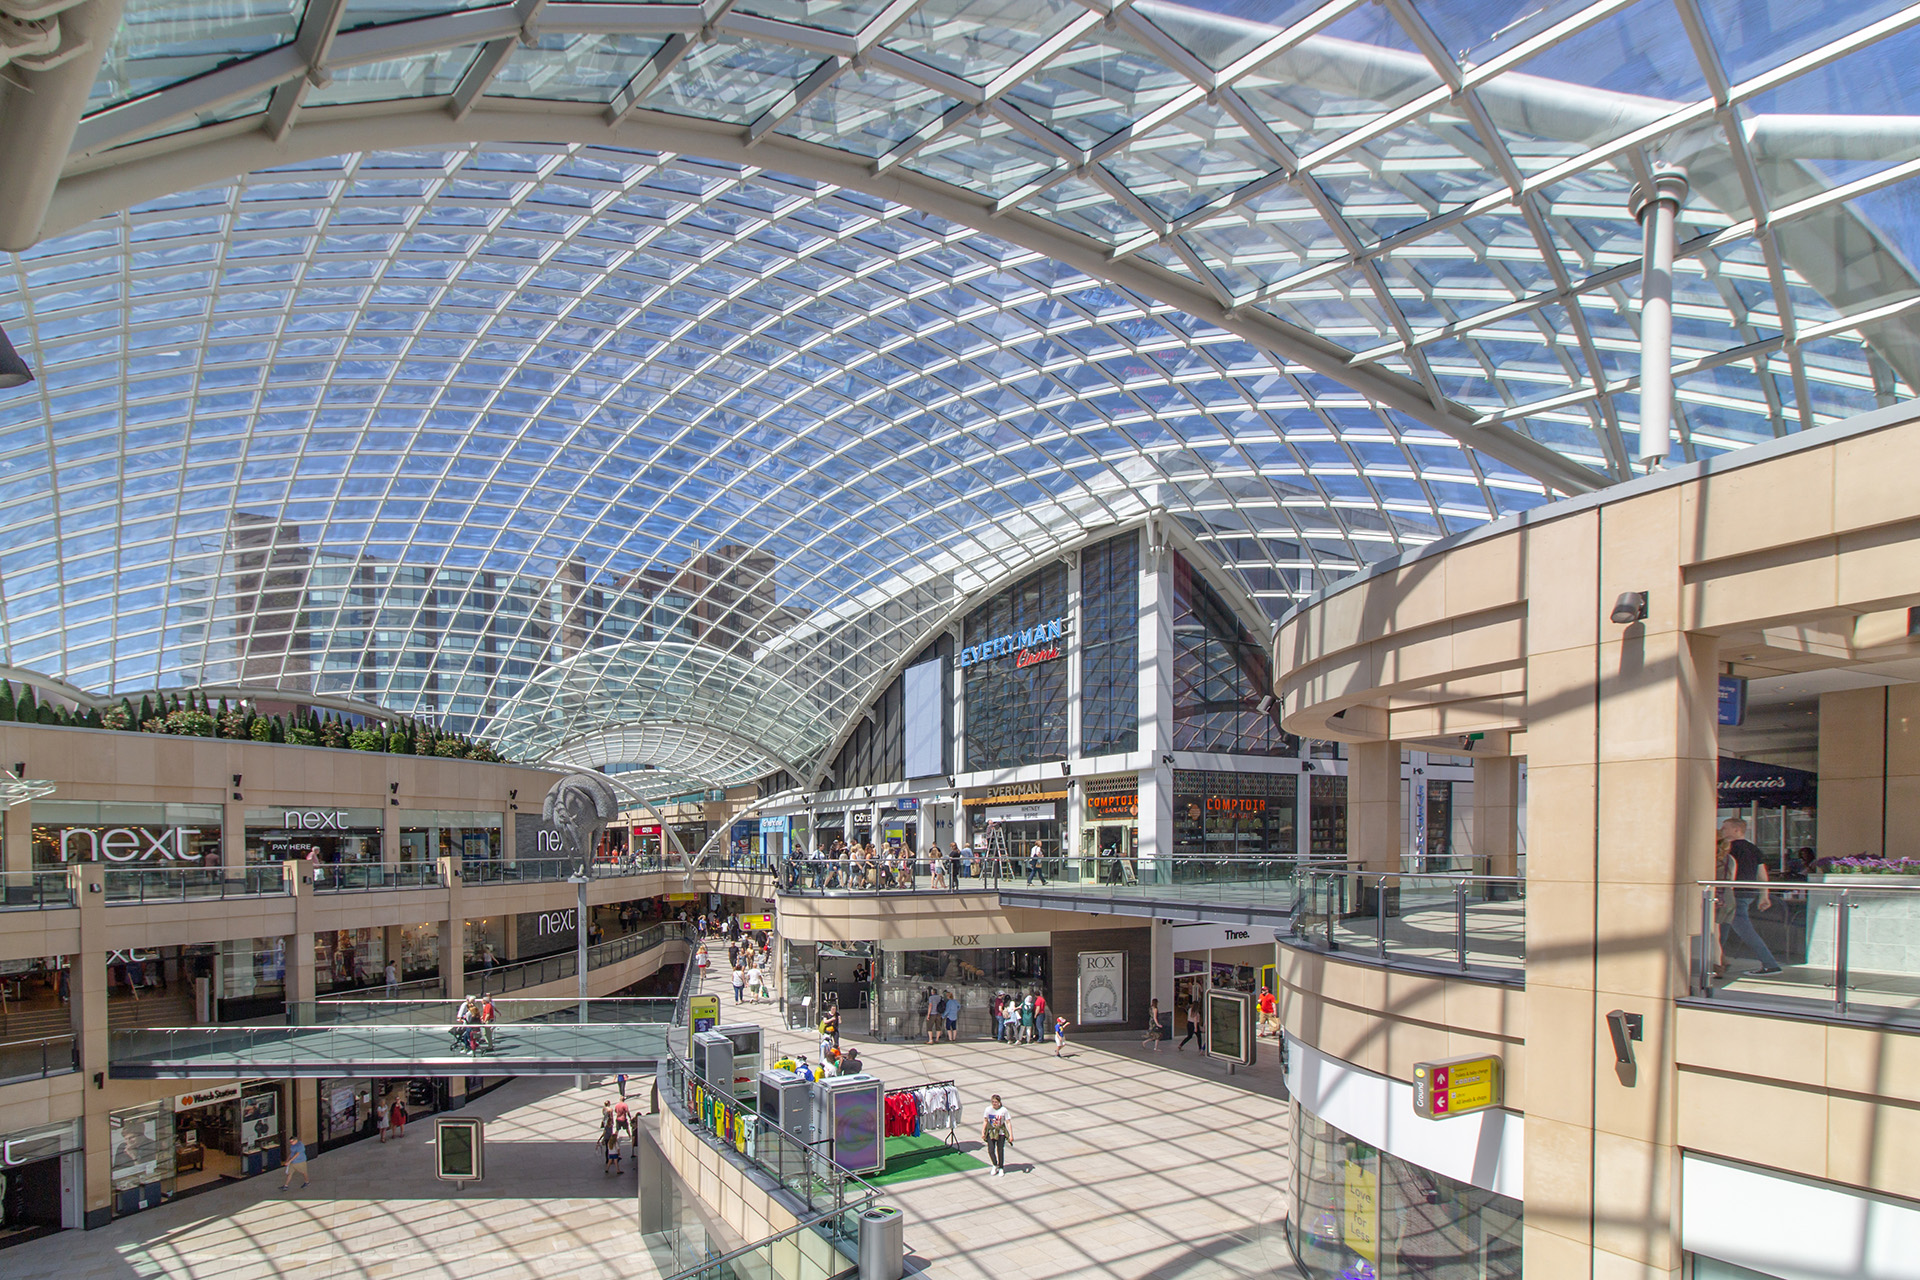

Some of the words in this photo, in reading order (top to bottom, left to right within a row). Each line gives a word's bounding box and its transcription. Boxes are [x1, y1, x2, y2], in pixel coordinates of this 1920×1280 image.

[961, 617, 1063, 667] EVERYMAN
[1016, 647, 1061, 669] Cinema
[987, 783, 1041, 798] EVERYMAN
[1717, 776, 1787, 790] arluccio's
[1087, 795, 1138, 807] COMPTOIR
[1206, 798, 1266, 811] COMPTOIR
[1099, 806, 1128, 814] LIBANAIS
[284, 810, 349, 830] next
[59, 826, 201, 863] next
[537, 829, 563, 851] ne
[539, 908, 576, 936] next
[952, 935, 981, 946] ROX
[1224, 930, 1250, 940] Three.
[106, 948, 147, 965] xt
[1087, 956, 1115, 969] ROX
[193, 1091, 215, 1103] Watch
[215, 1089, 238, 1099] Station
[1416, 1081, 1425, 1108] Ground
[1350, 1183, 1372, 1204] Love
[1357, 1200, 1364, 1214] it
[1350, 1222, 1371, 1244] Less
